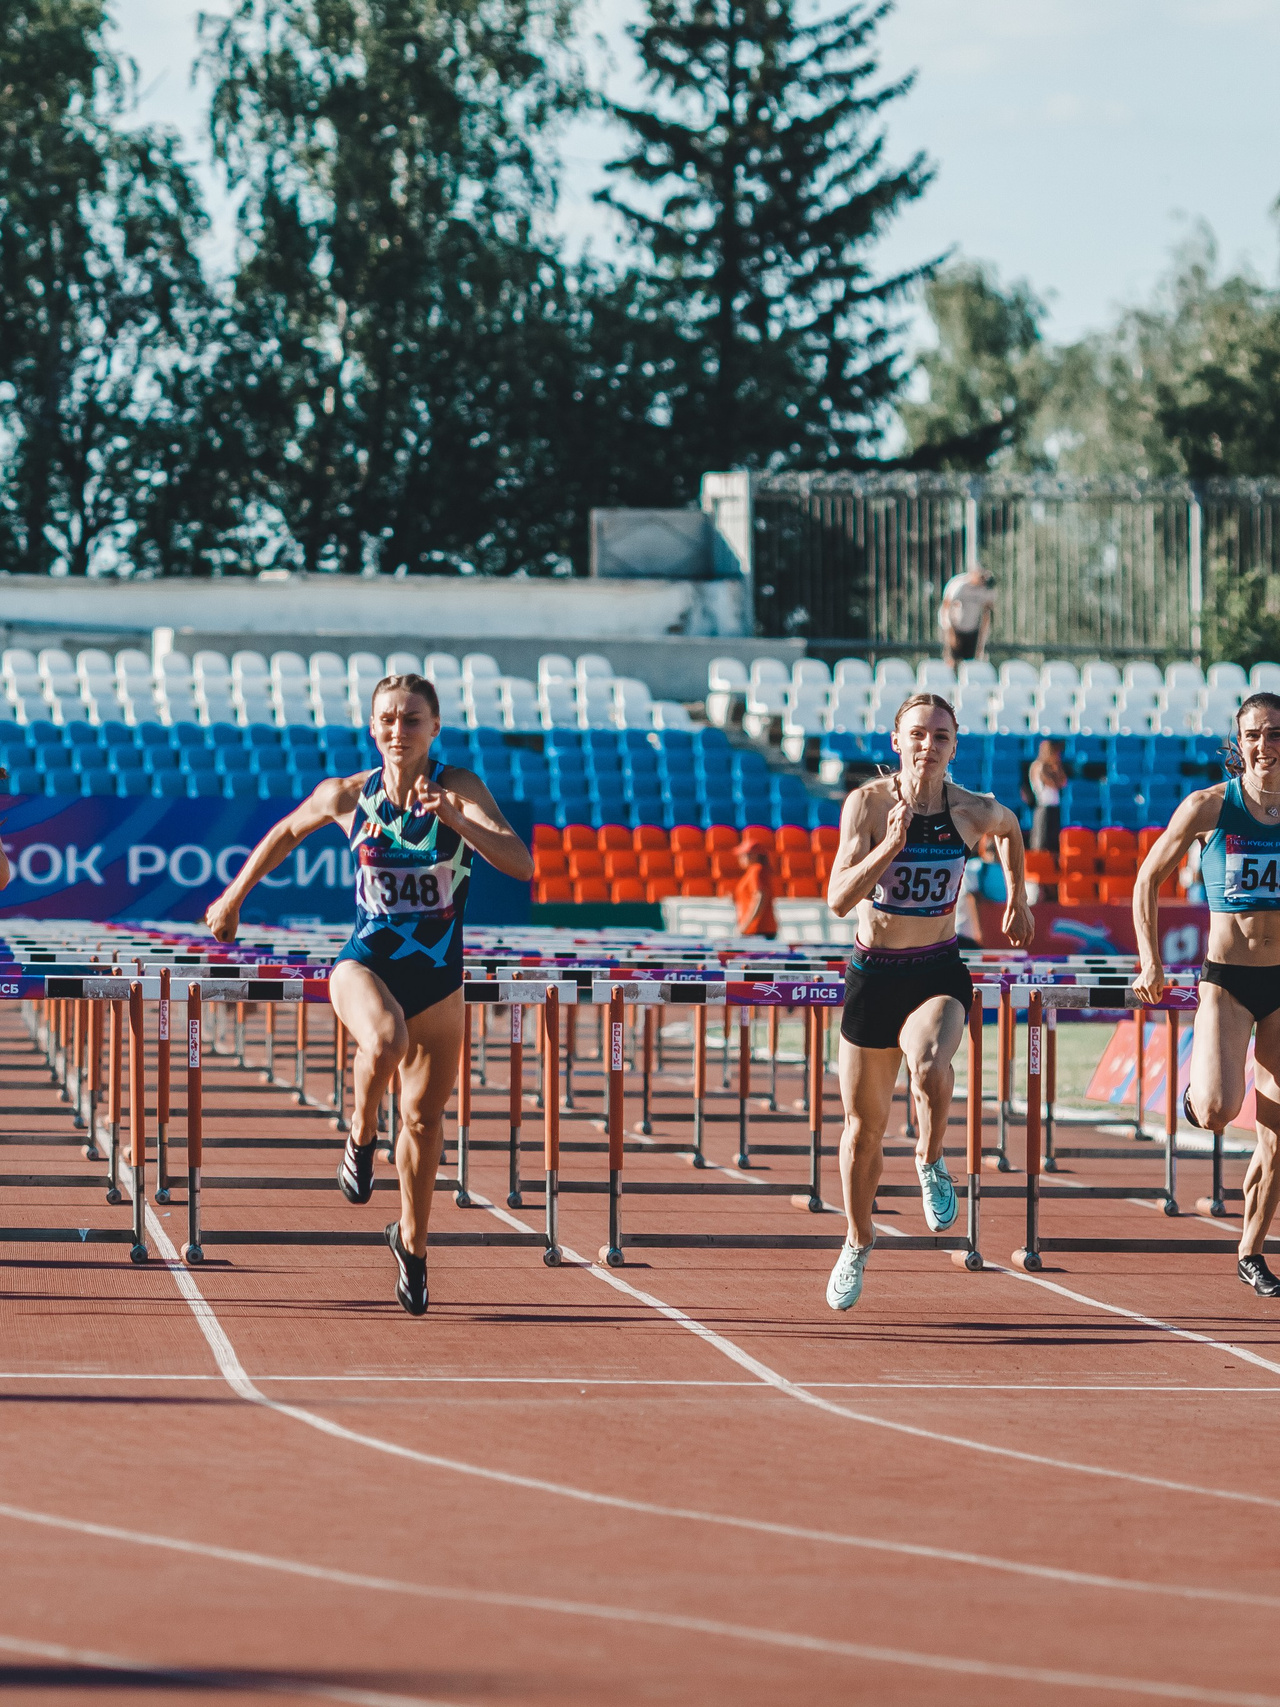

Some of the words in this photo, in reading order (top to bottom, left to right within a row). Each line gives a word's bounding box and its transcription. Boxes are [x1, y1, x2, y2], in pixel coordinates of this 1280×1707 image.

[903, 847, 928, 855] КУБОК
[930, 848, 963, 856] РОССИИ
[378, 871, 440, 907] 348
[891, 866, 951, 902] 353
[1241, 858, 1280, 893] 54
[810, 988, 838, 999] ПСБ
[1031, 974, 1055, 984] ПСБ
[190, 1020, 198, 1062] POLANIK
[613, 1023, 621, 1065] POLANIK
[1031, 1028, 1039, 1069] POLANIK
